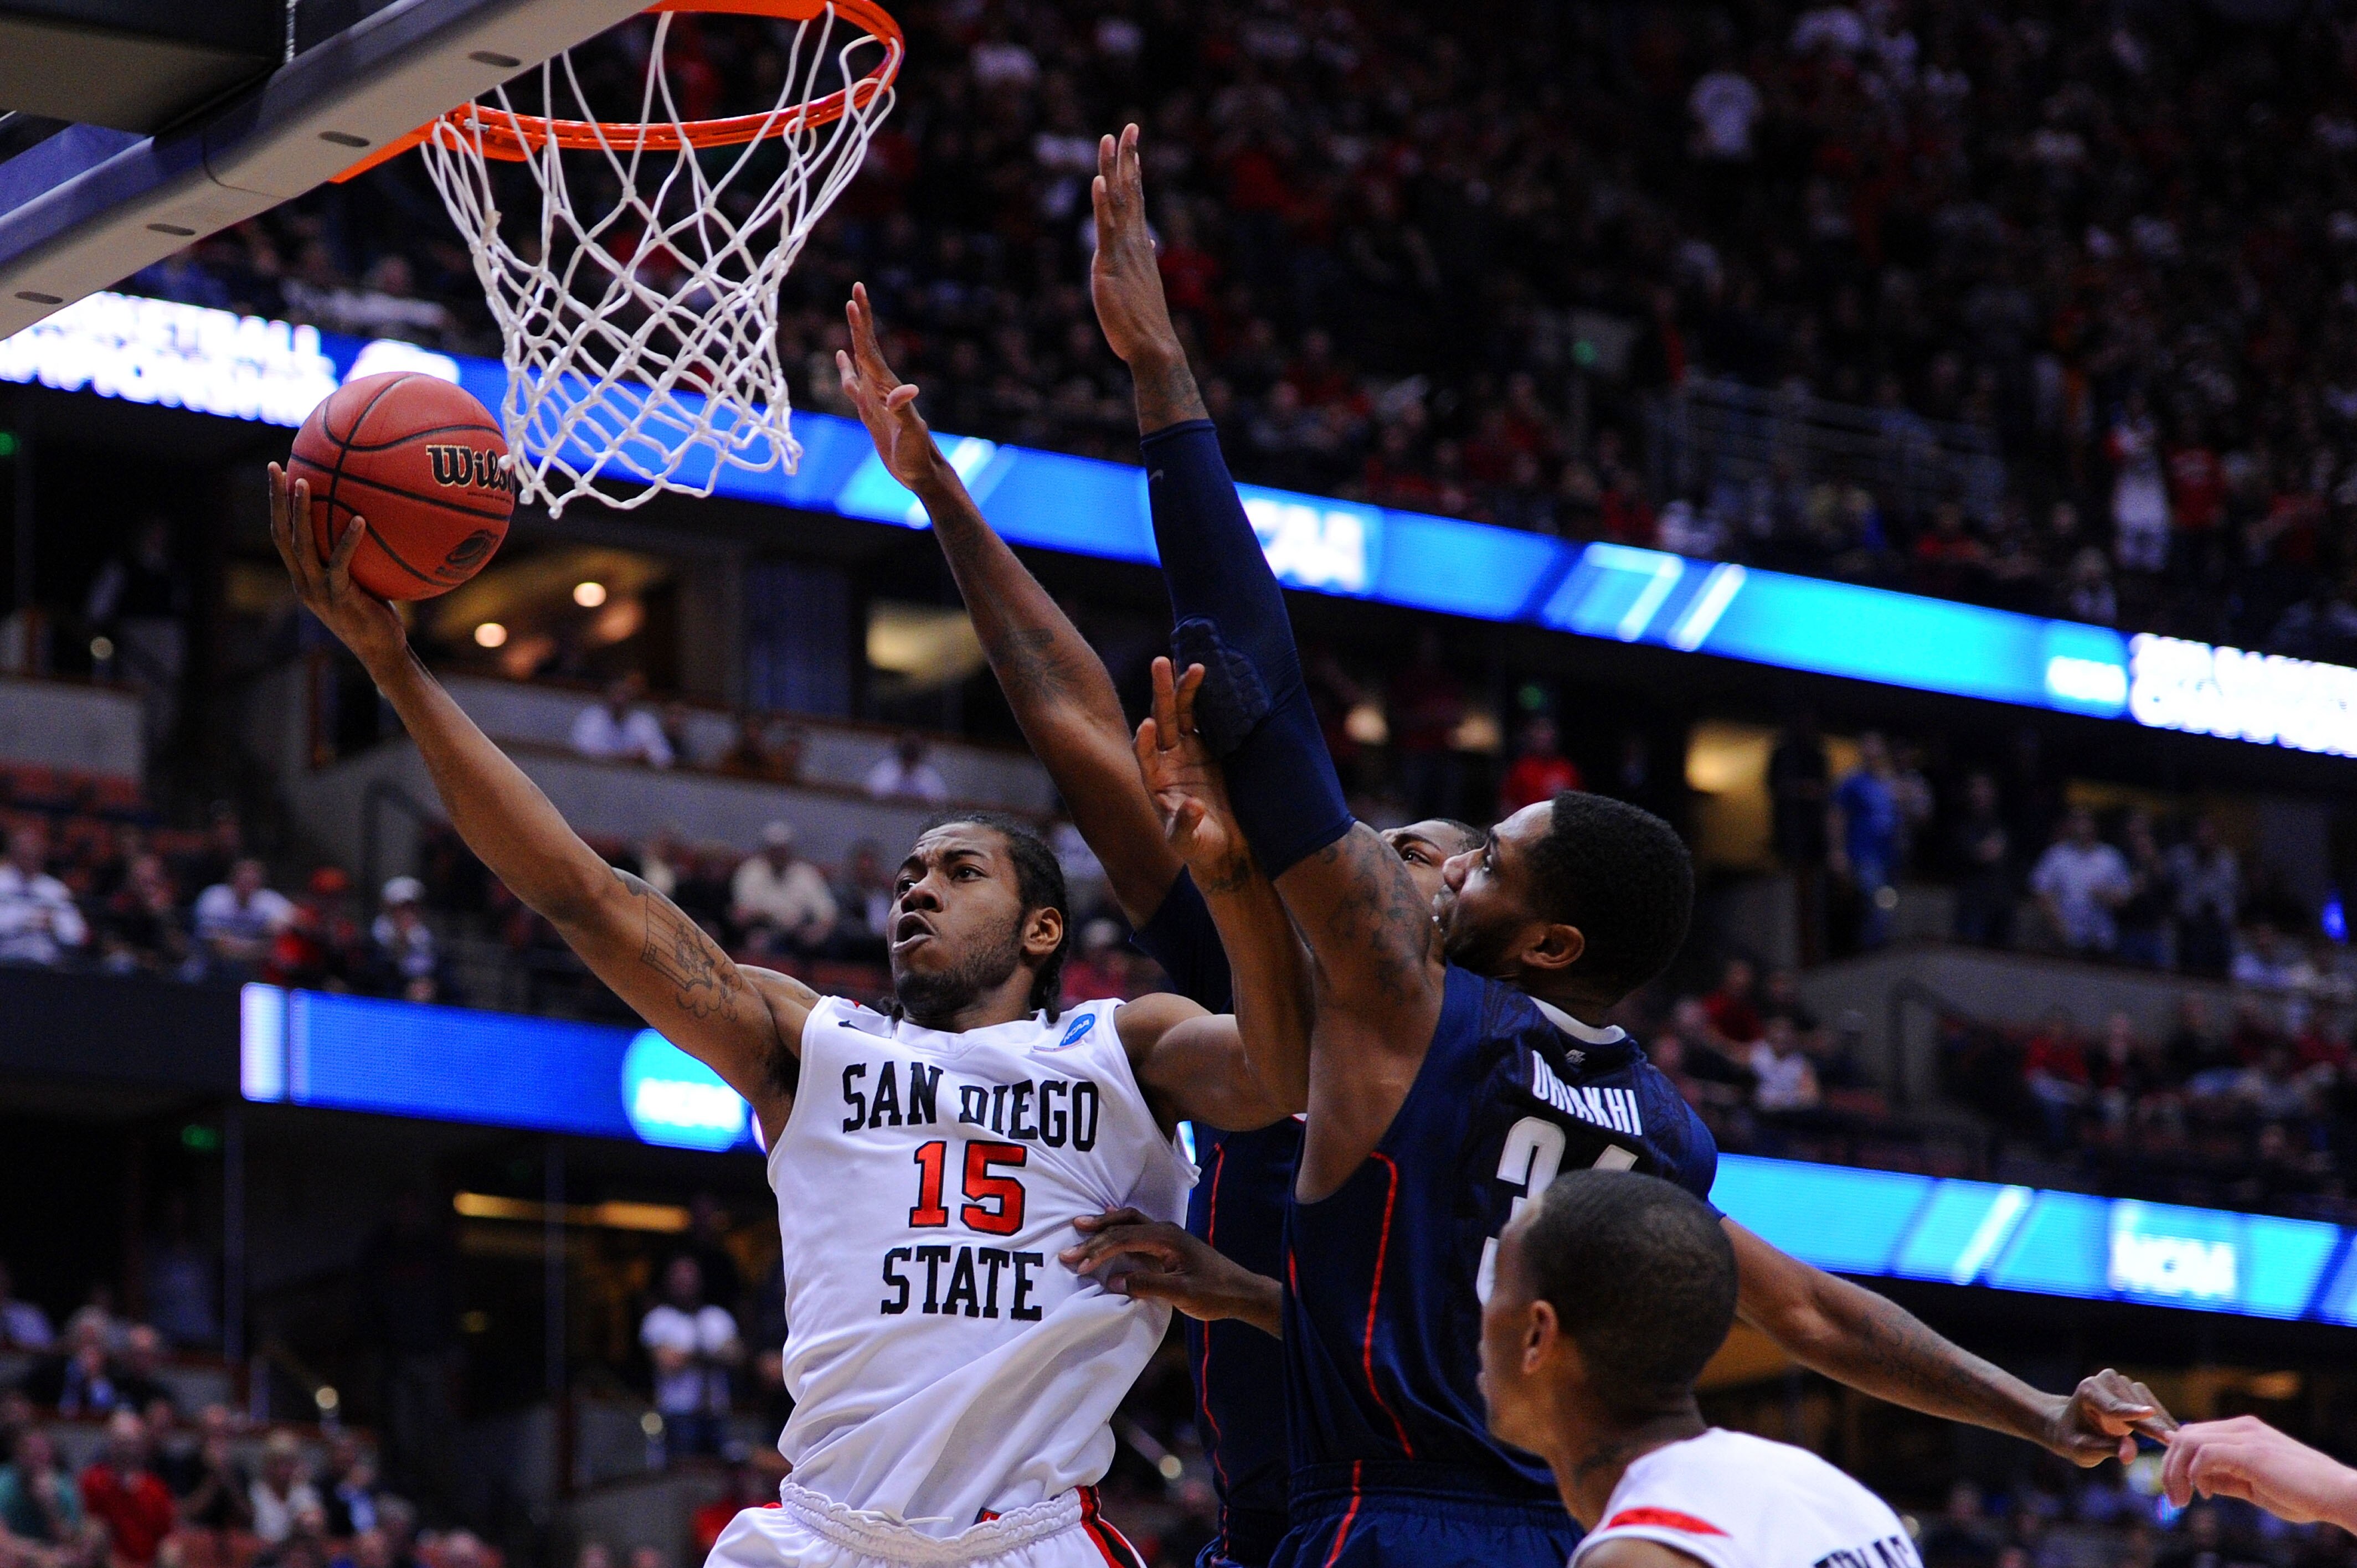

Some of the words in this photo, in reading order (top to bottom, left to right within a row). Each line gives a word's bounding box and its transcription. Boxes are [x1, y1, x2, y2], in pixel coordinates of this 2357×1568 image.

[842, 1061, 944, 1133] SAN
[959, 1079, 1099, 1152] DIEGO
[908, 1139, 1027, 1236] 15
[881, 1245, 1044, 1321] STATE
